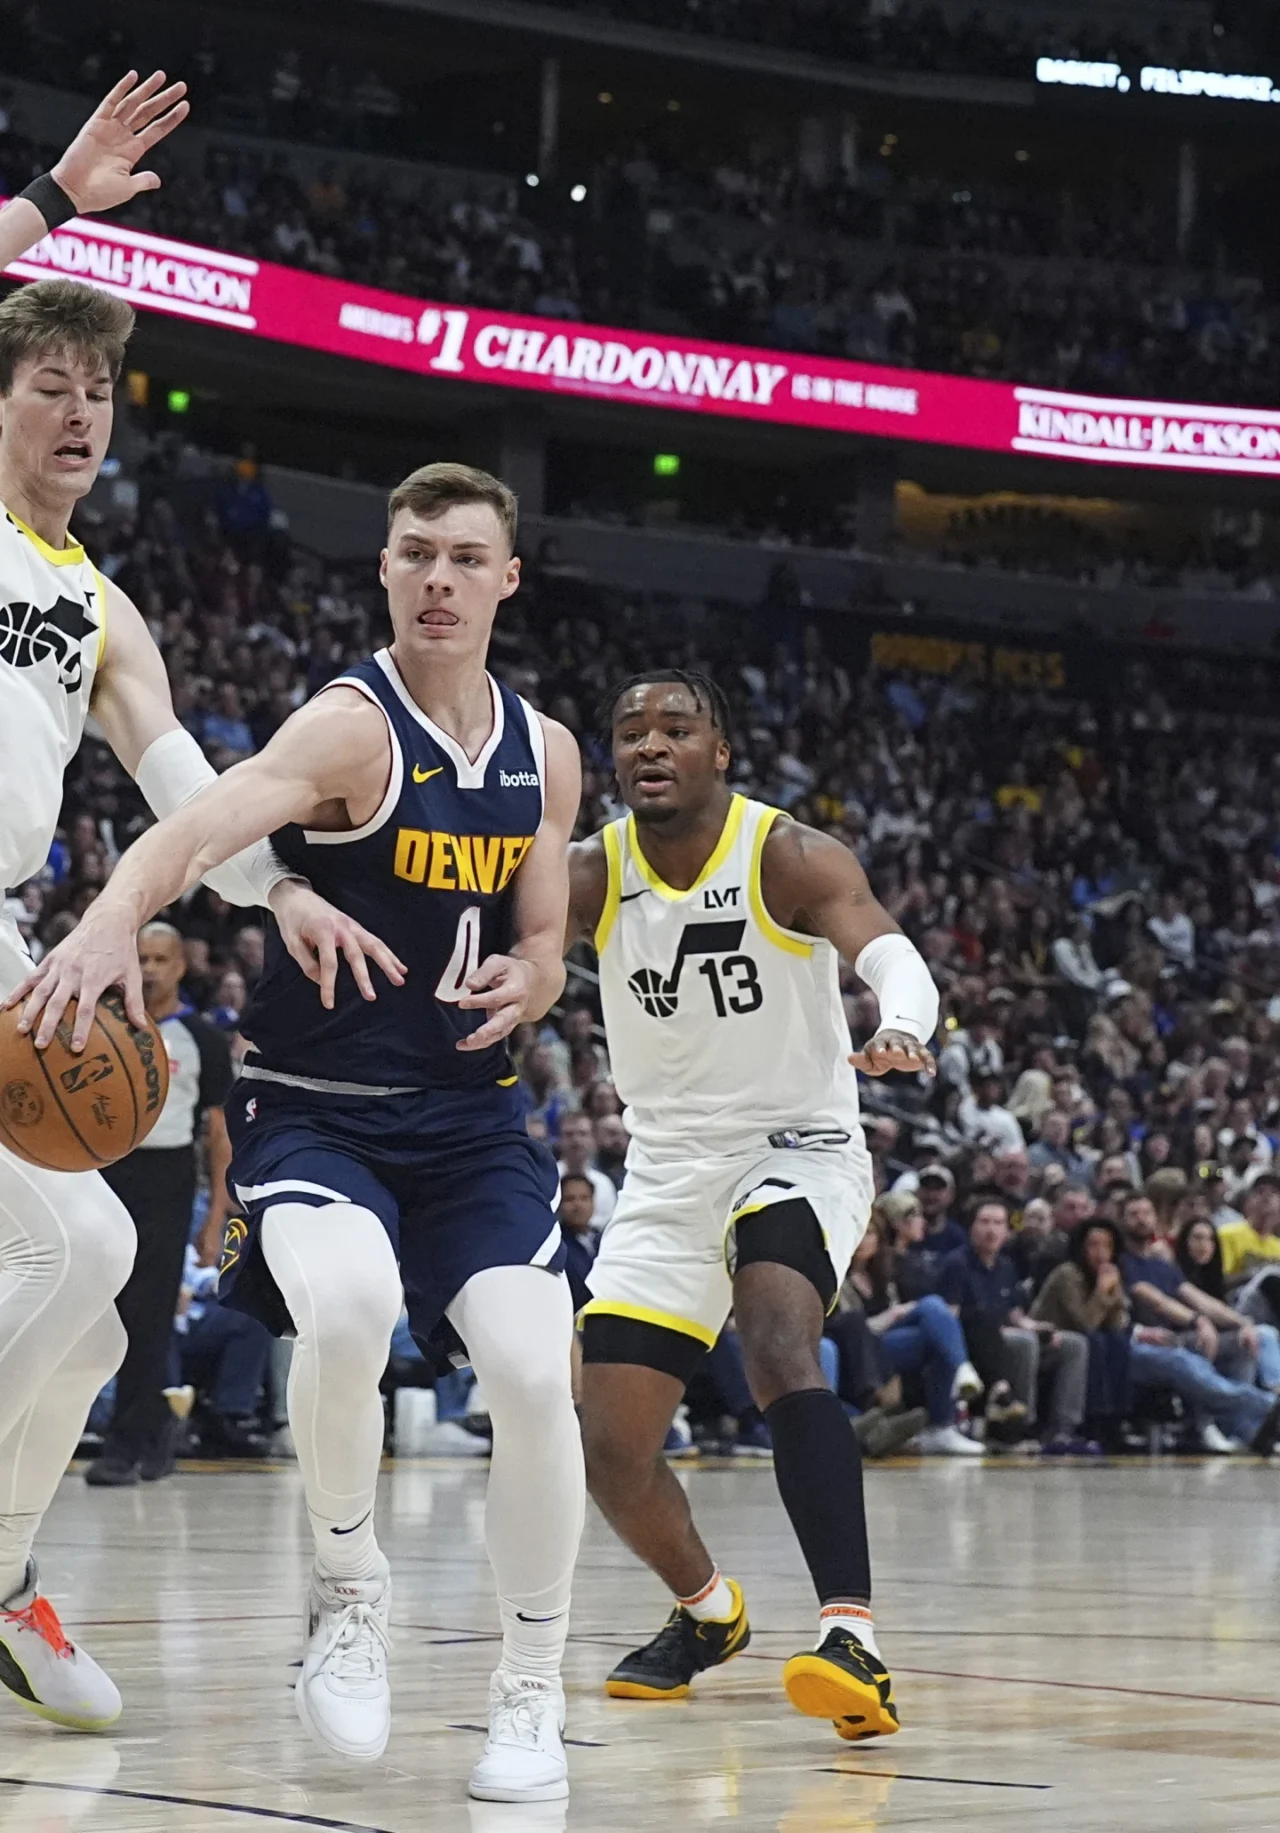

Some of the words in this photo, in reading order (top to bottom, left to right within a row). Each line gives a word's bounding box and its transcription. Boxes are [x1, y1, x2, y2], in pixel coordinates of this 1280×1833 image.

[473, 324, 789, 405] CHARDONNAY
[499, 769, 539, 788] ibotta
[393, 827, 535, 895] DENVE
[704, 887, 741, 909] LVT
[435, 905, 481, 1003] 0
[699, 955, 763, 1018] 13
